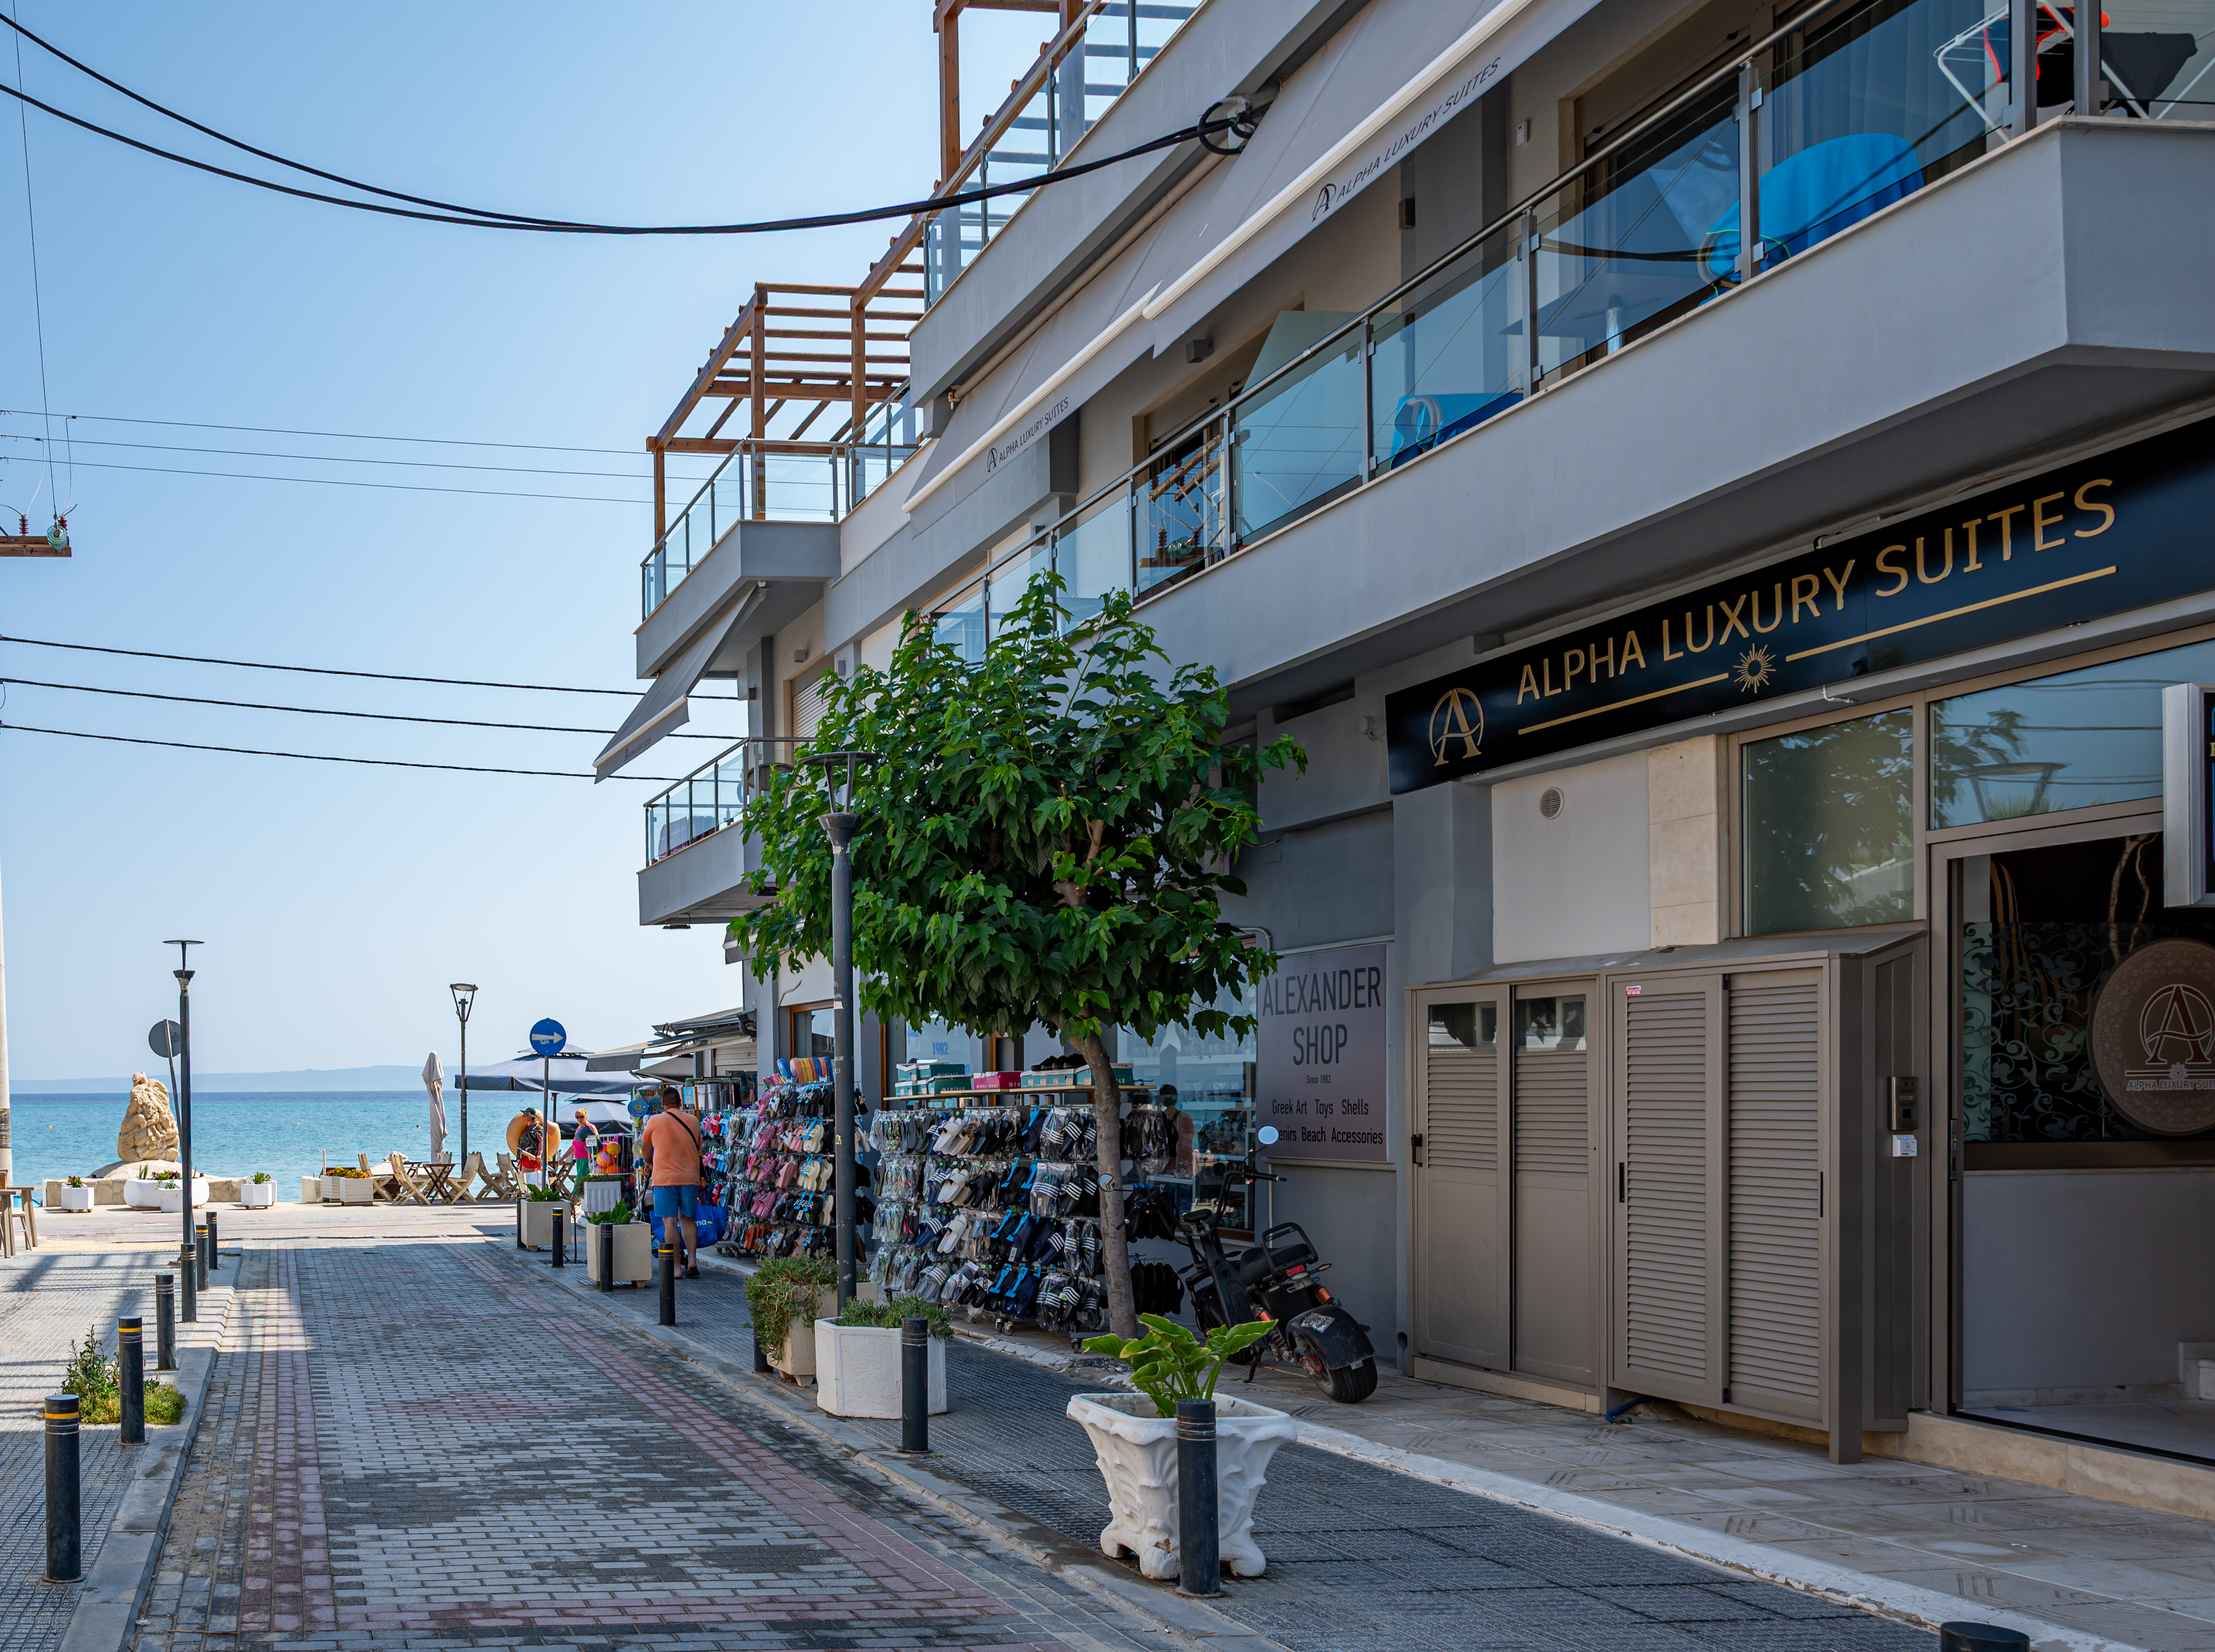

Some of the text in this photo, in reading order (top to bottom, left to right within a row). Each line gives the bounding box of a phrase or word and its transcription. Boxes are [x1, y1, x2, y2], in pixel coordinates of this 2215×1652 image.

[1336, 156, 1380, 202] ALPHA
[1384, 105, 1443, 162] LUXURY
[1443, 57, 1501, 114] SUITES
[999, 439, 1018, 463] ALPHA
[1020, 417, 1043, 446] LUXURY
[1045, 397, 1069, 425] SUITES
[1517, 630, 1646, 705] ALPHA
[1663, 559, 1855, 661] LUXURY
[1875, 479, 2116, 597] SUITES
[1262, 966, 1381, 1017] ALEXANDER
[933, 1042, 948, 1055] 1982
[1293, 1024, 1348, 1066] SHOP
[1307, 1074, 1331, 1084] Since 1982
[2127, 1080, 2158, 1091] ALPHA
[2160, 1080, 2194, 1090] LUXURY
[1272, 1098, 1369, 1118] Greek Art Toys Shells
[1279, 1126, 1383, 1144] enirs Beach Accessories
